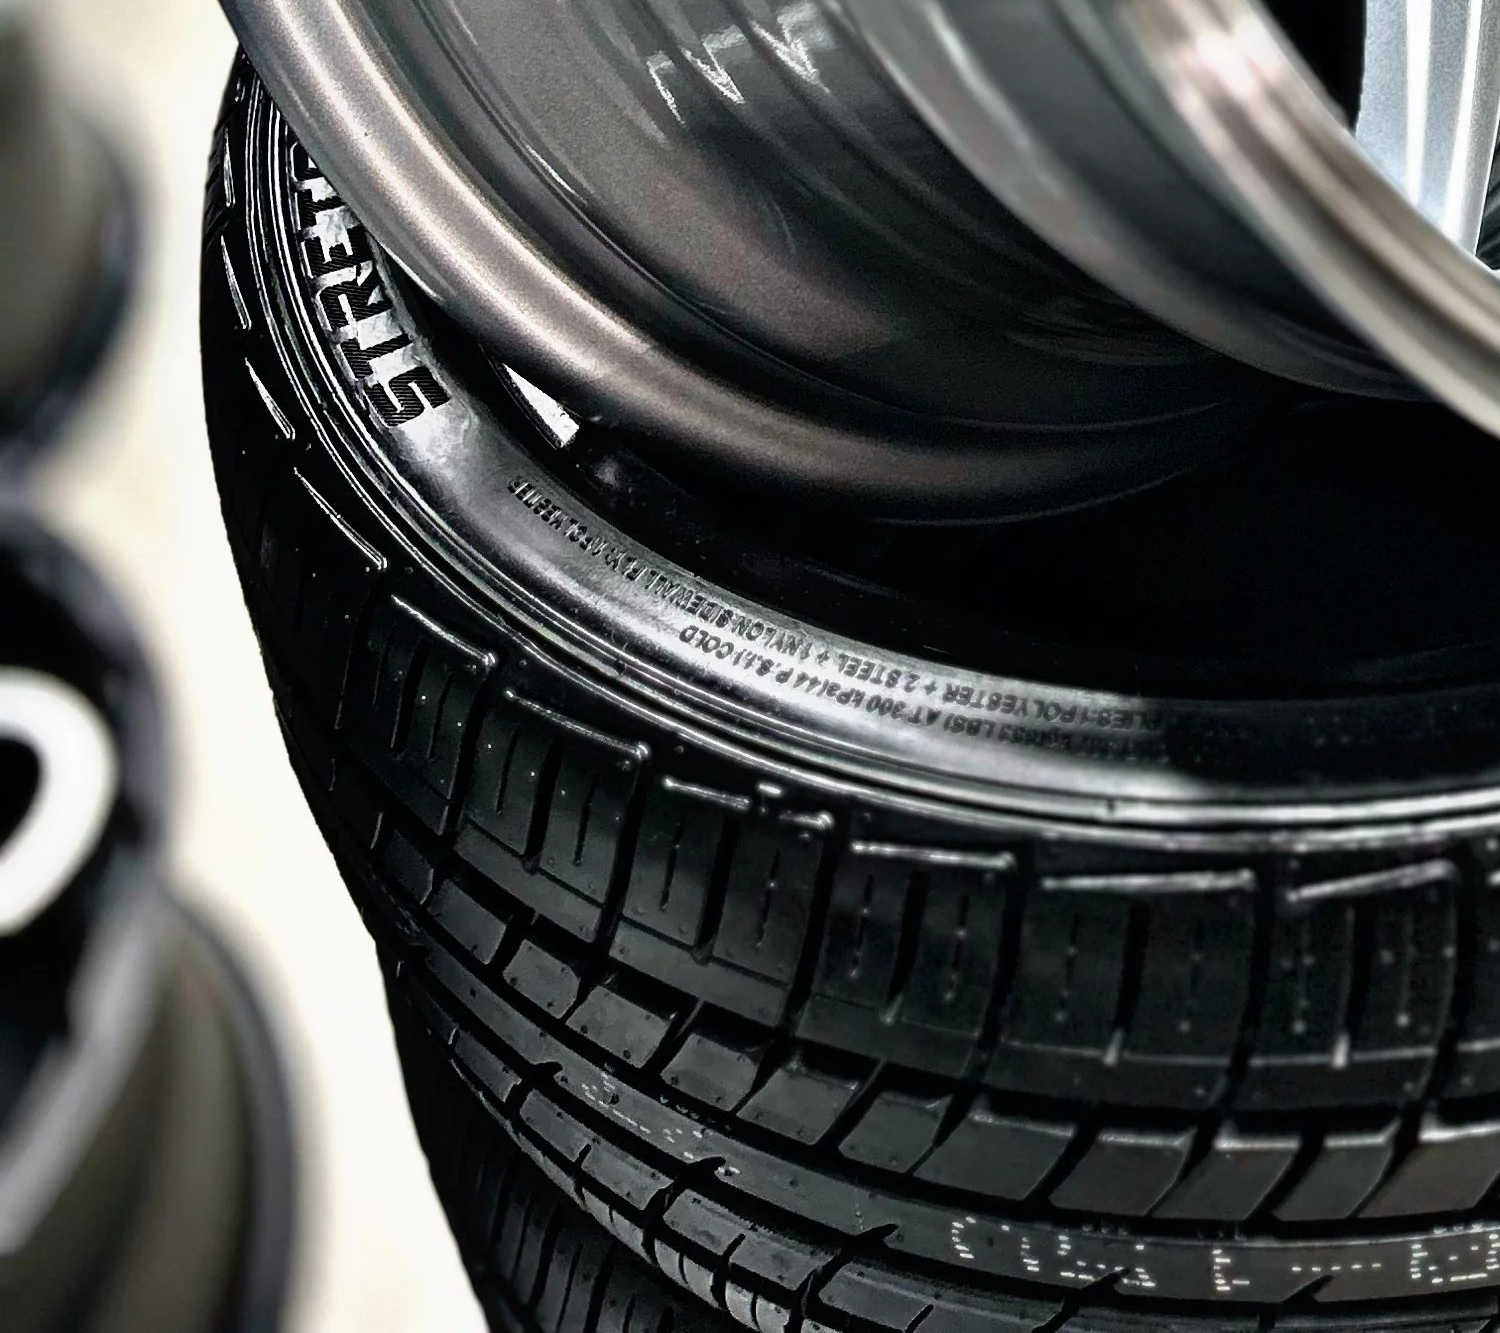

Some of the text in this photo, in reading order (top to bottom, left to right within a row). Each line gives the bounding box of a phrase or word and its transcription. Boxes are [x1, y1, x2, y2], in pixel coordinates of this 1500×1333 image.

[679, 624, 735, 659] COLD
[838, 652, 902, 689] STEEL
[866, 694, 906, 720] 300
[907, 705, 942, 726] AT
